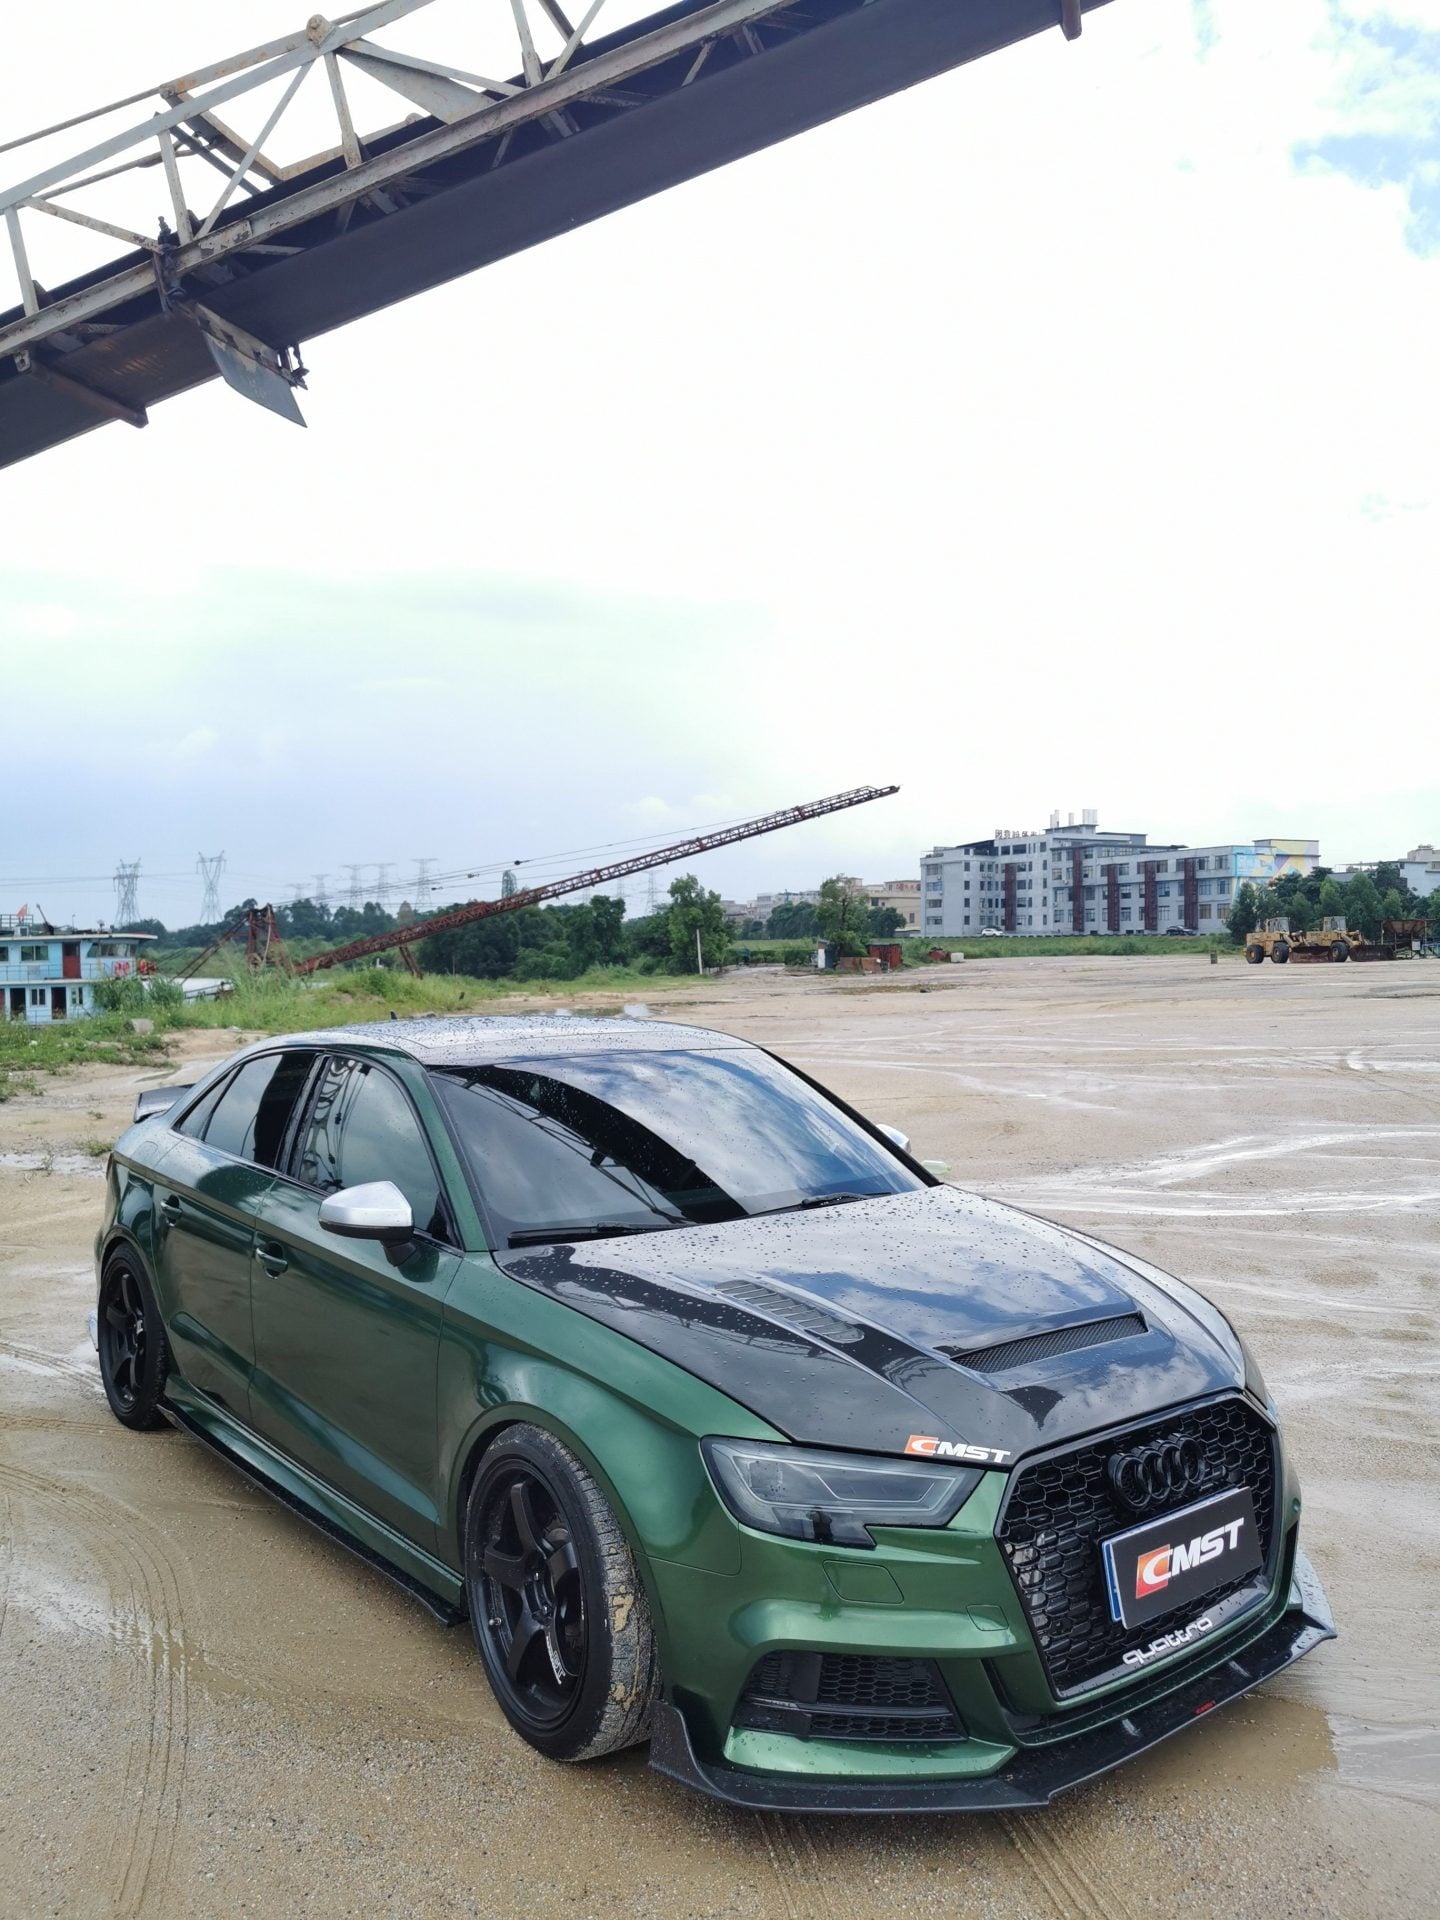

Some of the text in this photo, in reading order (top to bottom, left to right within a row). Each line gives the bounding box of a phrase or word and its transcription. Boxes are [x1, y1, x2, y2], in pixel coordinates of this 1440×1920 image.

[909, 1438, 1011, 1463] CMST
[1141, 1517, 1244, 1586] CMST
[1122, 1617, 1213, 1665] quattro
